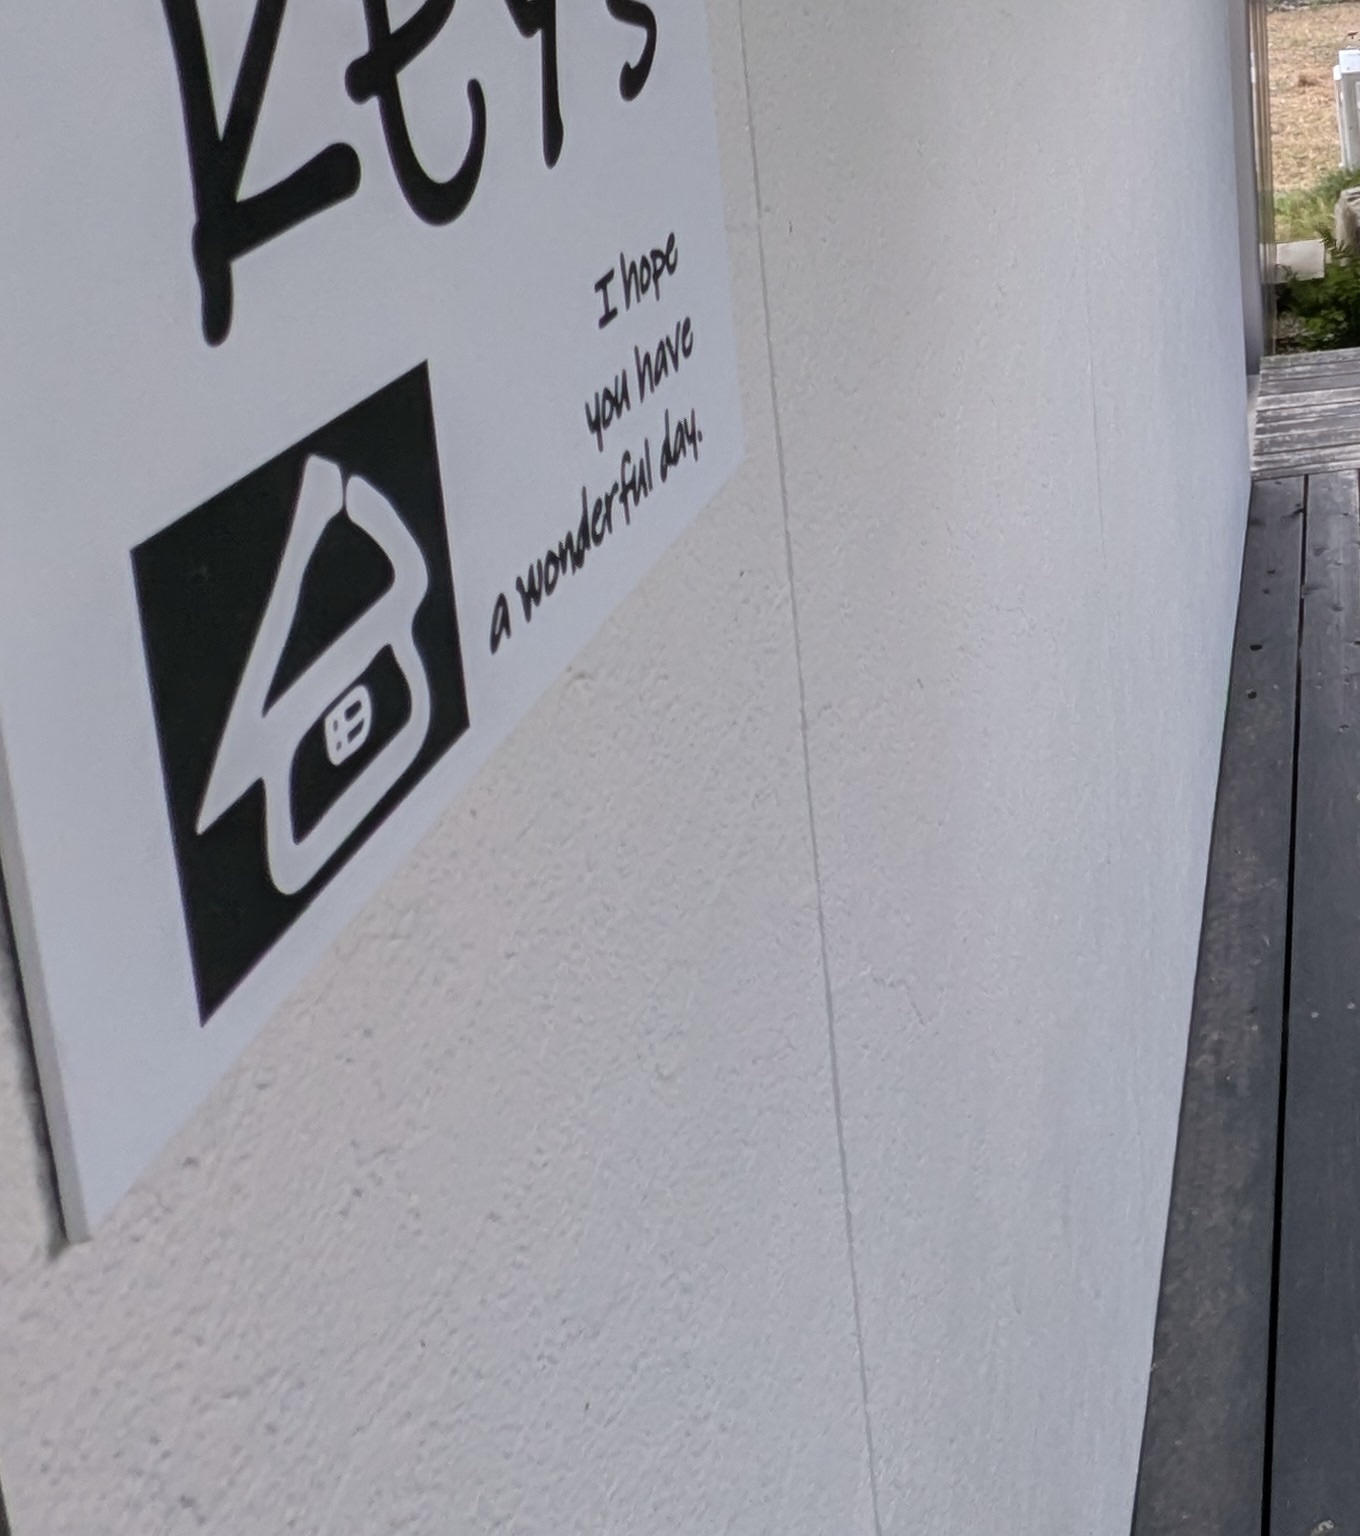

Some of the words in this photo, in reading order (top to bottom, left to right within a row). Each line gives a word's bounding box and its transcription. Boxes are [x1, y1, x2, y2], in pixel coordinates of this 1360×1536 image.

[594, 268, 619, 329] I
[620, 232, 678, 311] hope
[585, 369, 631, 452] you
[634, 316, 694, 404] have
[490, 592, 512, 655] a
[515, 437, 653, 623] wonderful
[660, 407, 704, 483] day.
